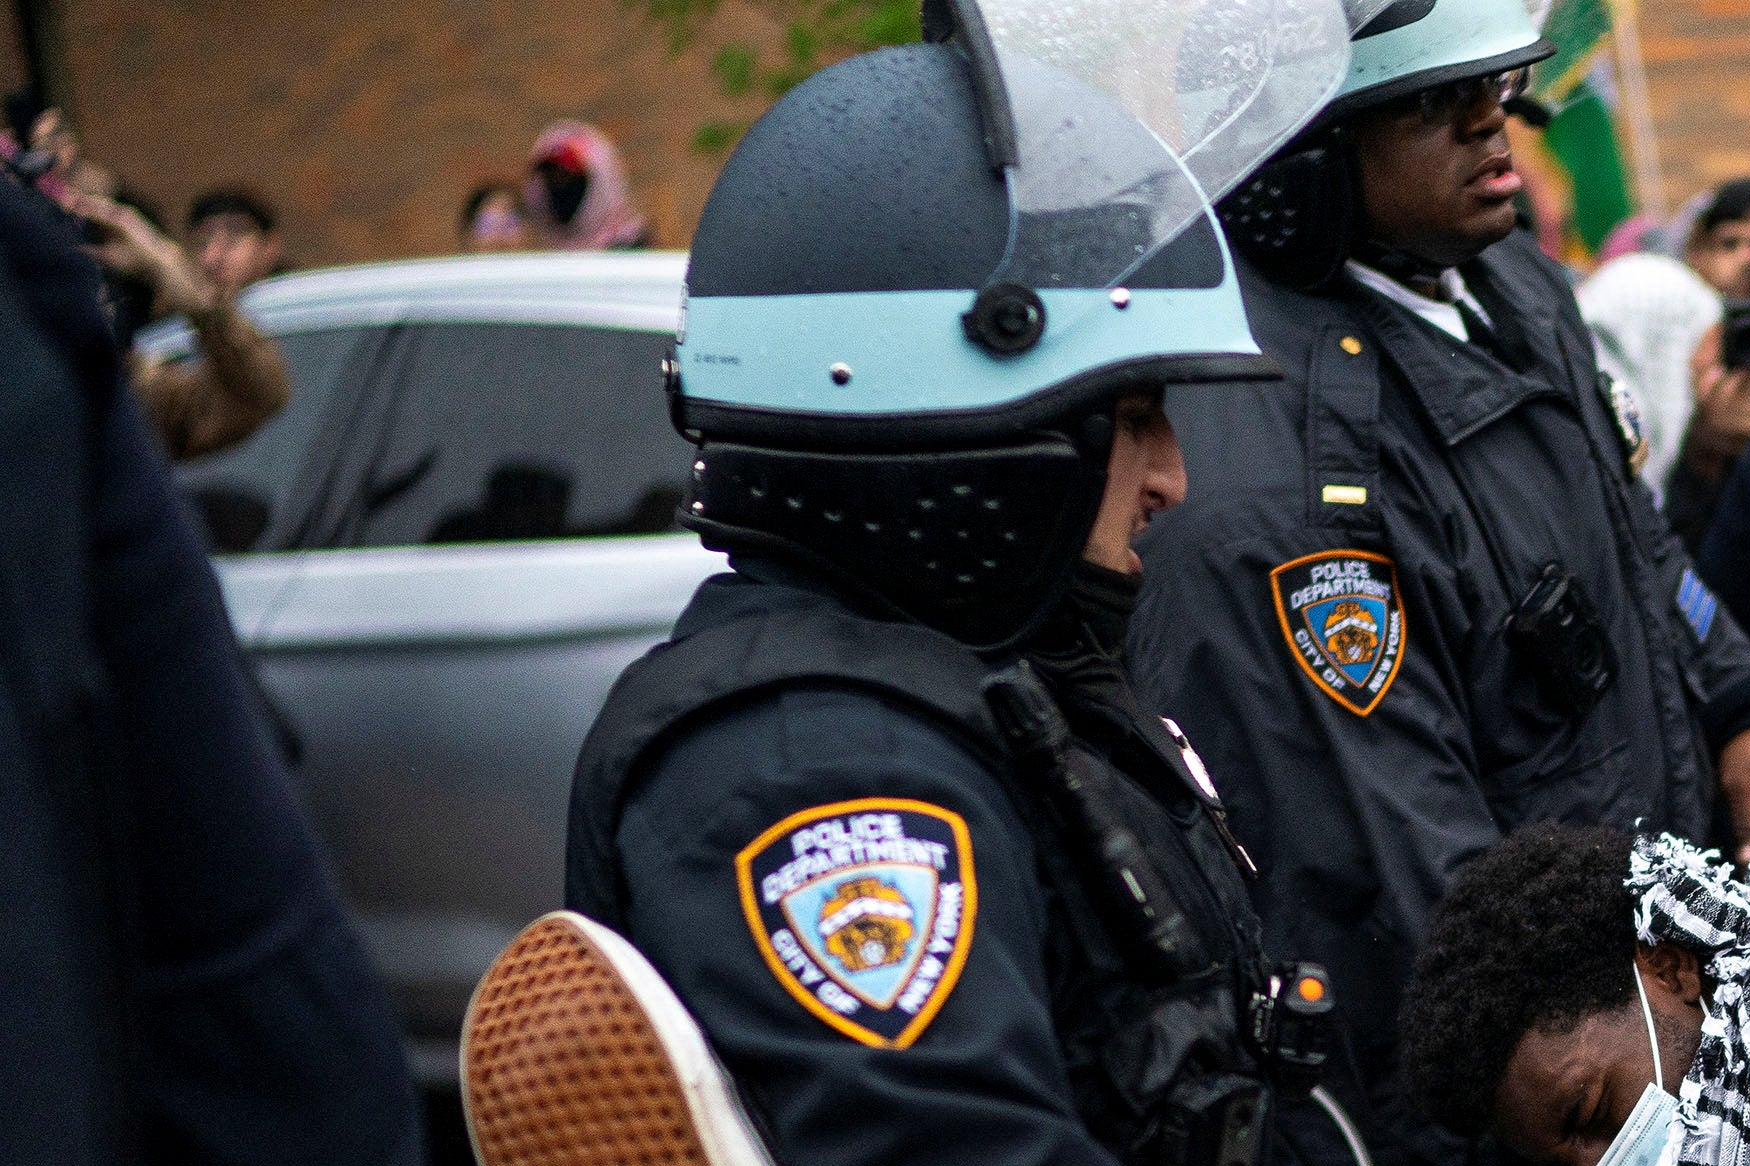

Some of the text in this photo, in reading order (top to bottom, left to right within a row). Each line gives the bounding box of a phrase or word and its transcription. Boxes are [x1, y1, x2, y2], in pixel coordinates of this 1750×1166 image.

[1290, 578, 1391, 609] DEPARTMENT
[1310, 560, 1371, 583] POLICE
[1295, 628, 1346, 689] CITY OF
[1368, 610, 1401, 693] NEW YORK
[791, 814, 903, 857] POLICE
[762, 837, 949, 904] DEPARTMENT
[771, 928, 862, 1015] CITY OF
[897, 882, 964, 1015] NEW YORK
